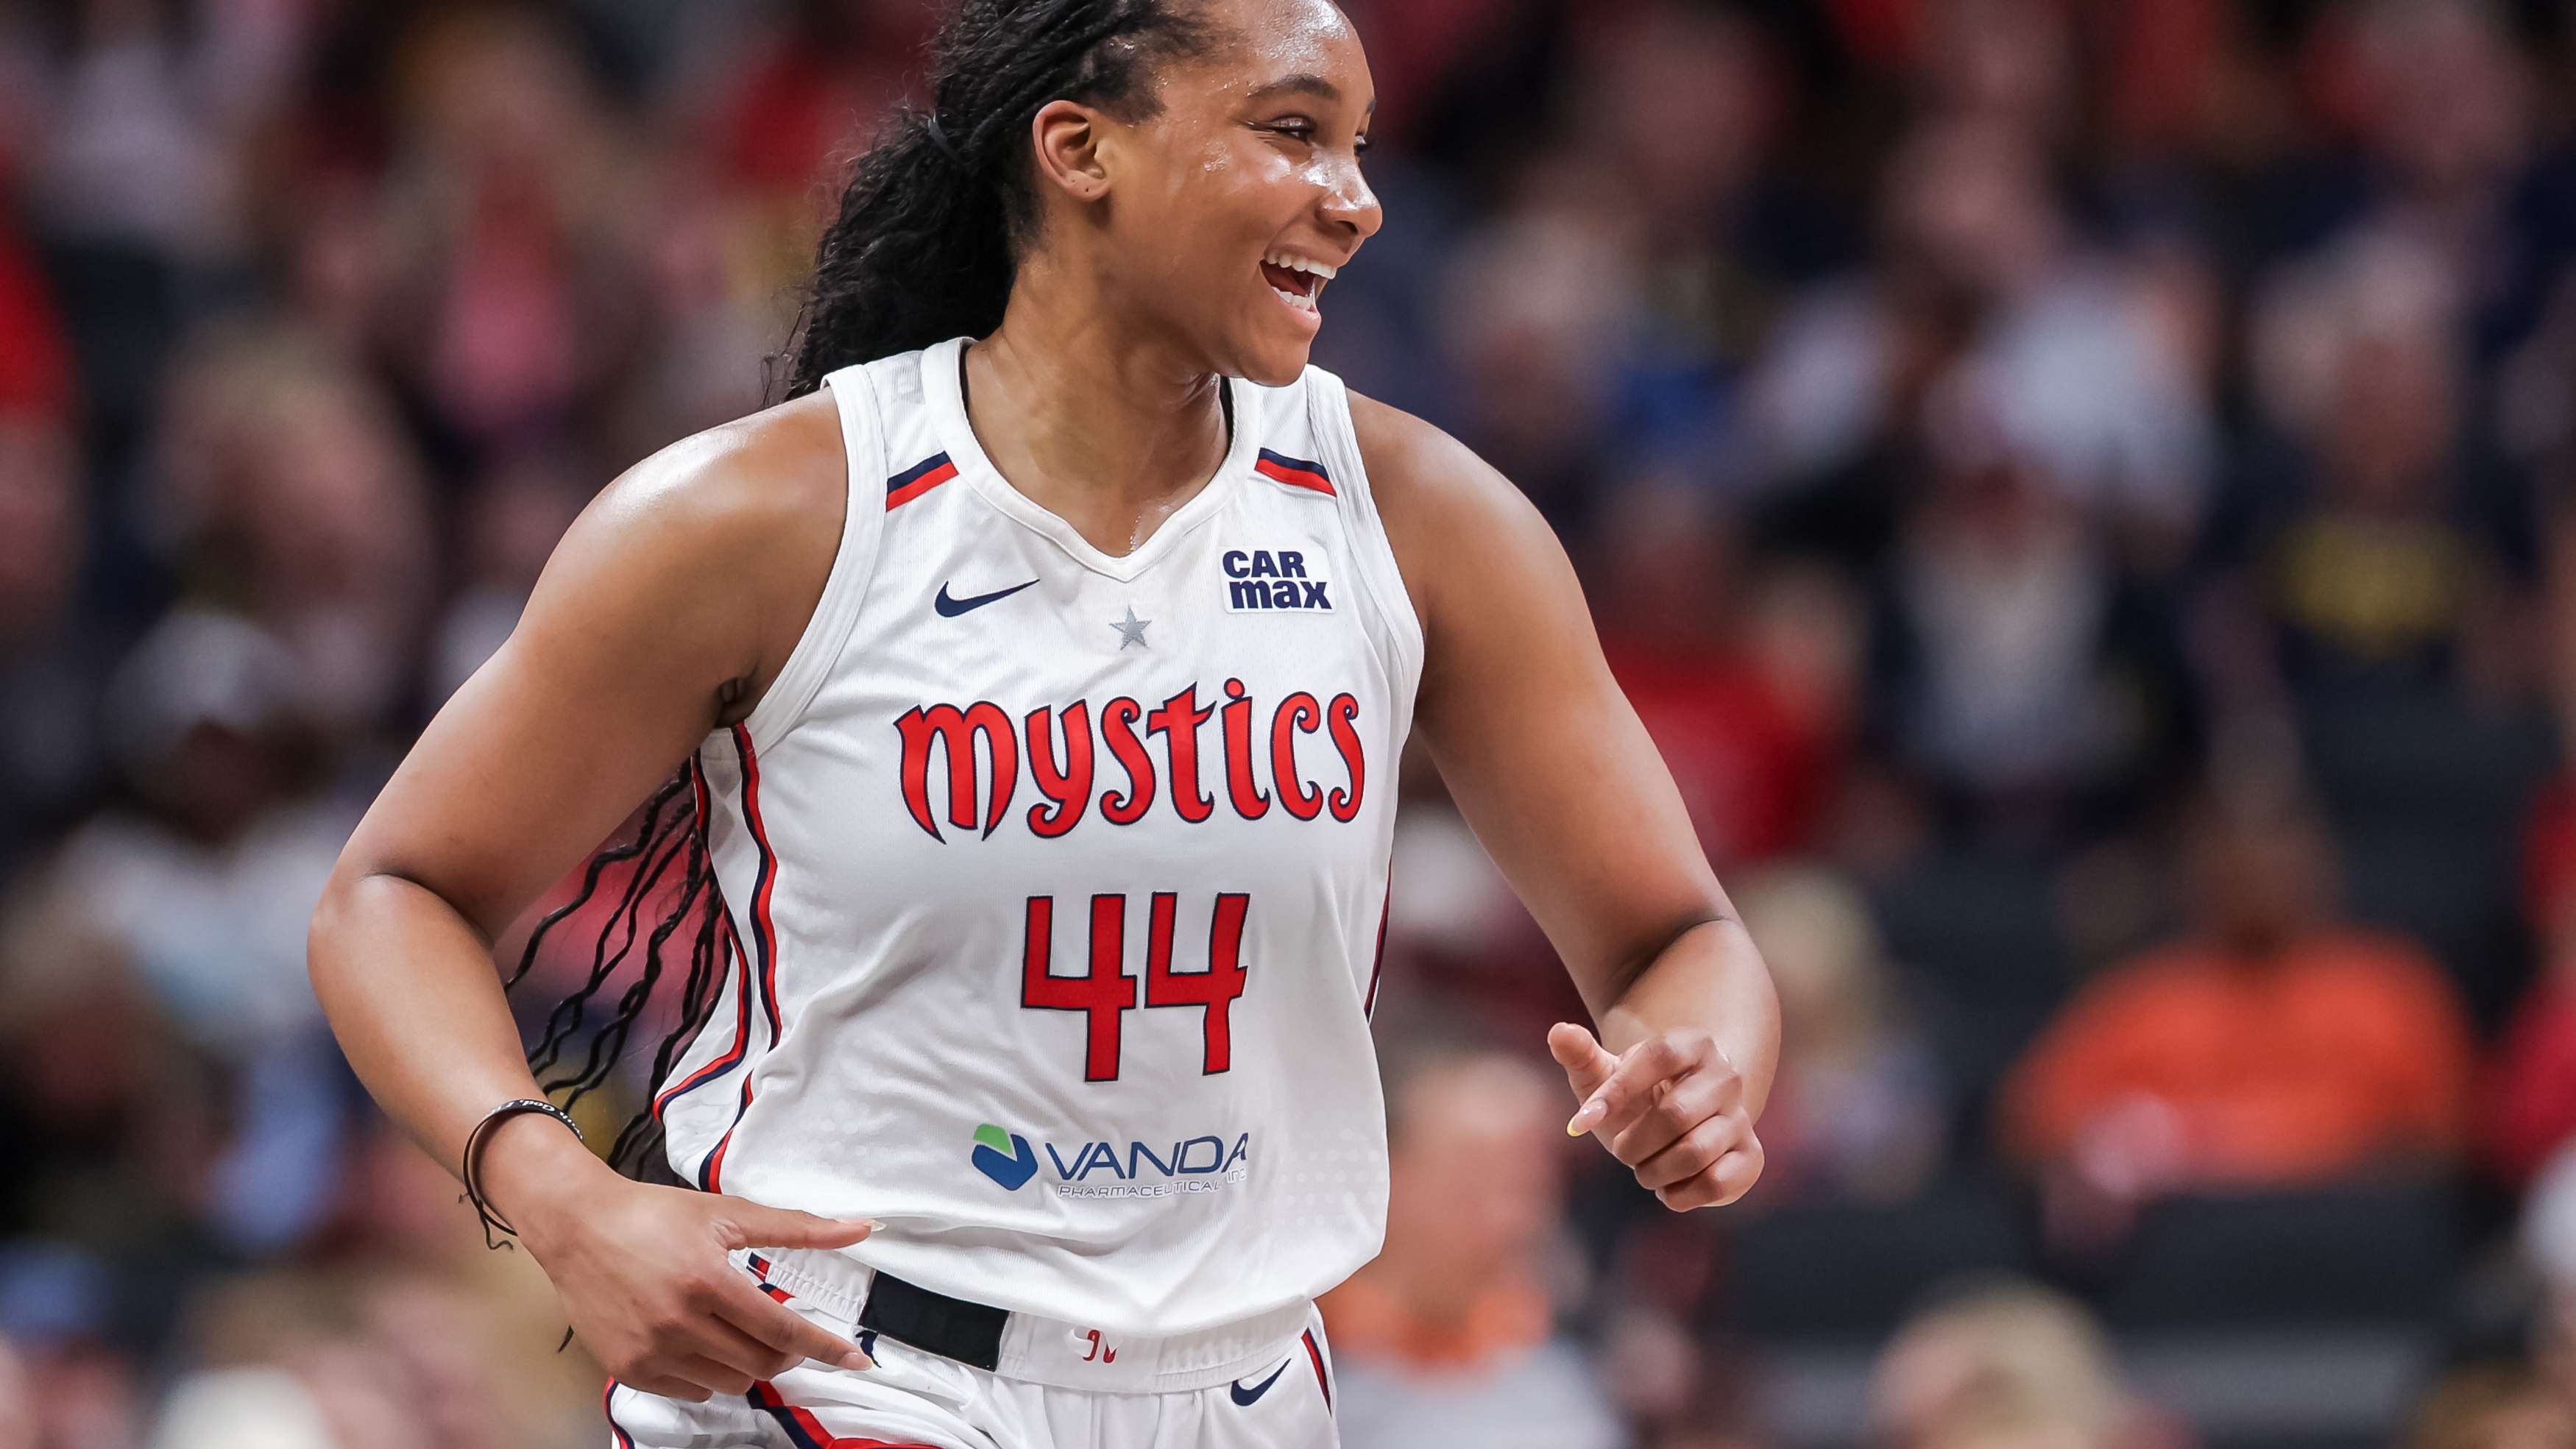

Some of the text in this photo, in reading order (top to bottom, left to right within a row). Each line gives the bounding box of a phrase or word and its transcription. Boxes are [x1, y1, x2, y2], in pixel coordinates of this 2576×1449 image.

[1222, 550, 1307, 578] CAR
[1229, 581, 1332, 609] max
[1020, 891, 1250, 1082] 44
[1045, 1133, 1249, 1180] VANDA
